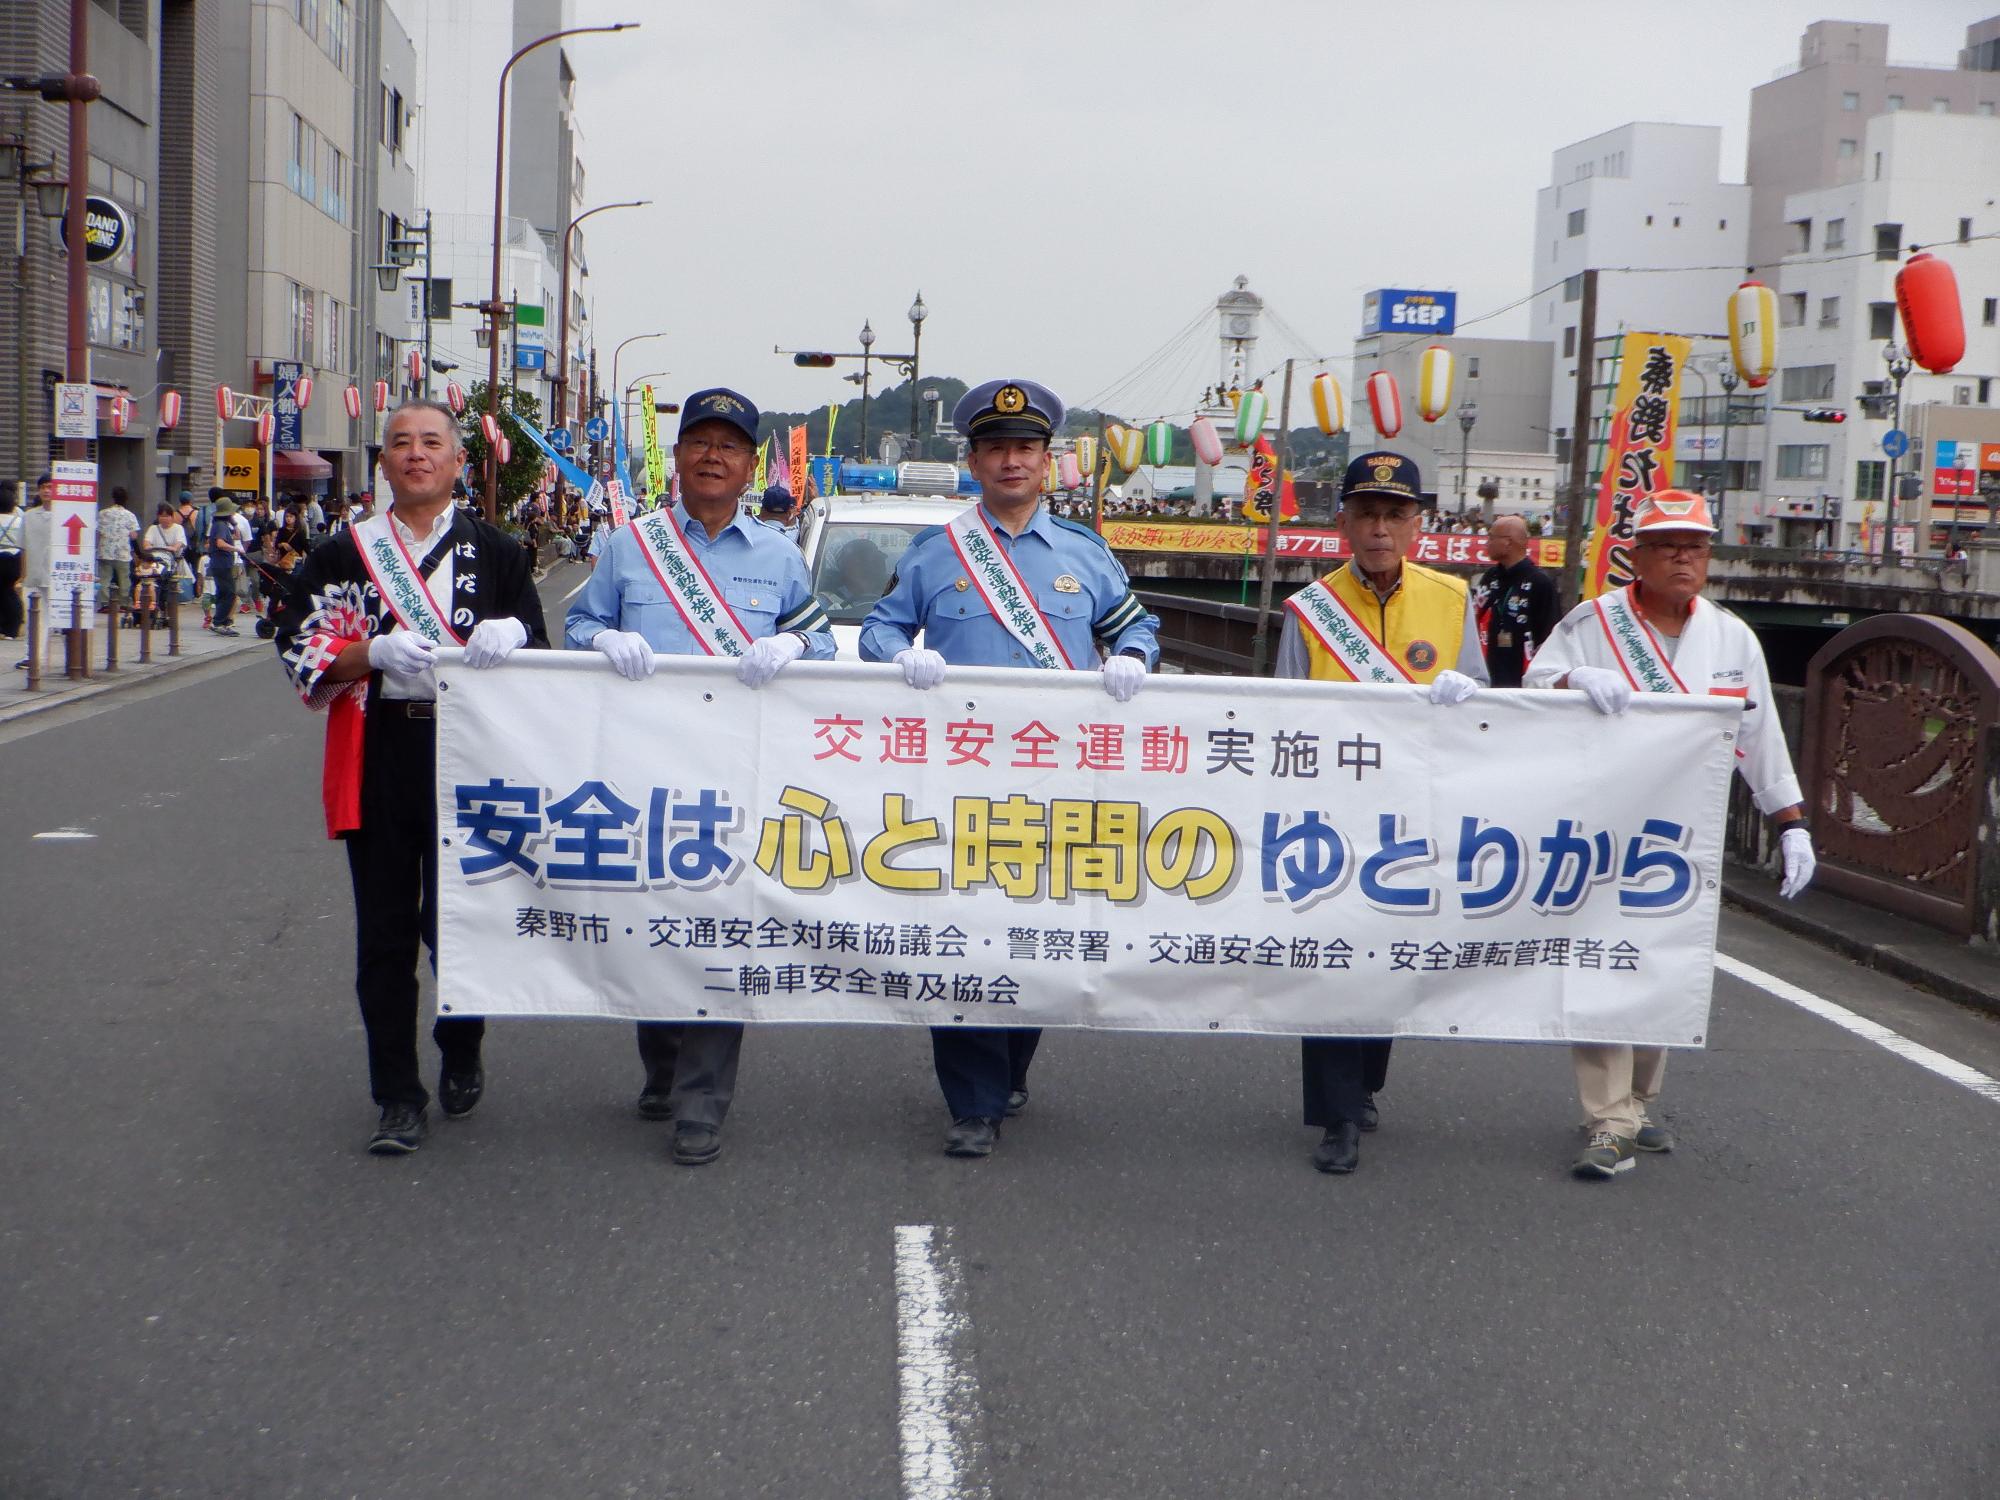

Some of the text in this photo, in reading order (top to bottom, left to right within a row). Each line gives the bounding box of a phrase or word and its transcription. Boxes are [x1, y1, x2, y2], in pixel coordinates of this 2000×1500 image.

[372, 537, 441, 644] 交通安全運動実施中
[454, 541, 477, 627] はだの
[643, 516, 718, 624] 交通安全運動実施中
[962, 528, 1037, 638] 交通安全運動実施中
[1300, 586, 1370, 664] 安全運動実施中
[812, 713, 1382, 781] 交通安全運動実施中
[703, 962, 1021, 1005] 二輪車安全普及協会
